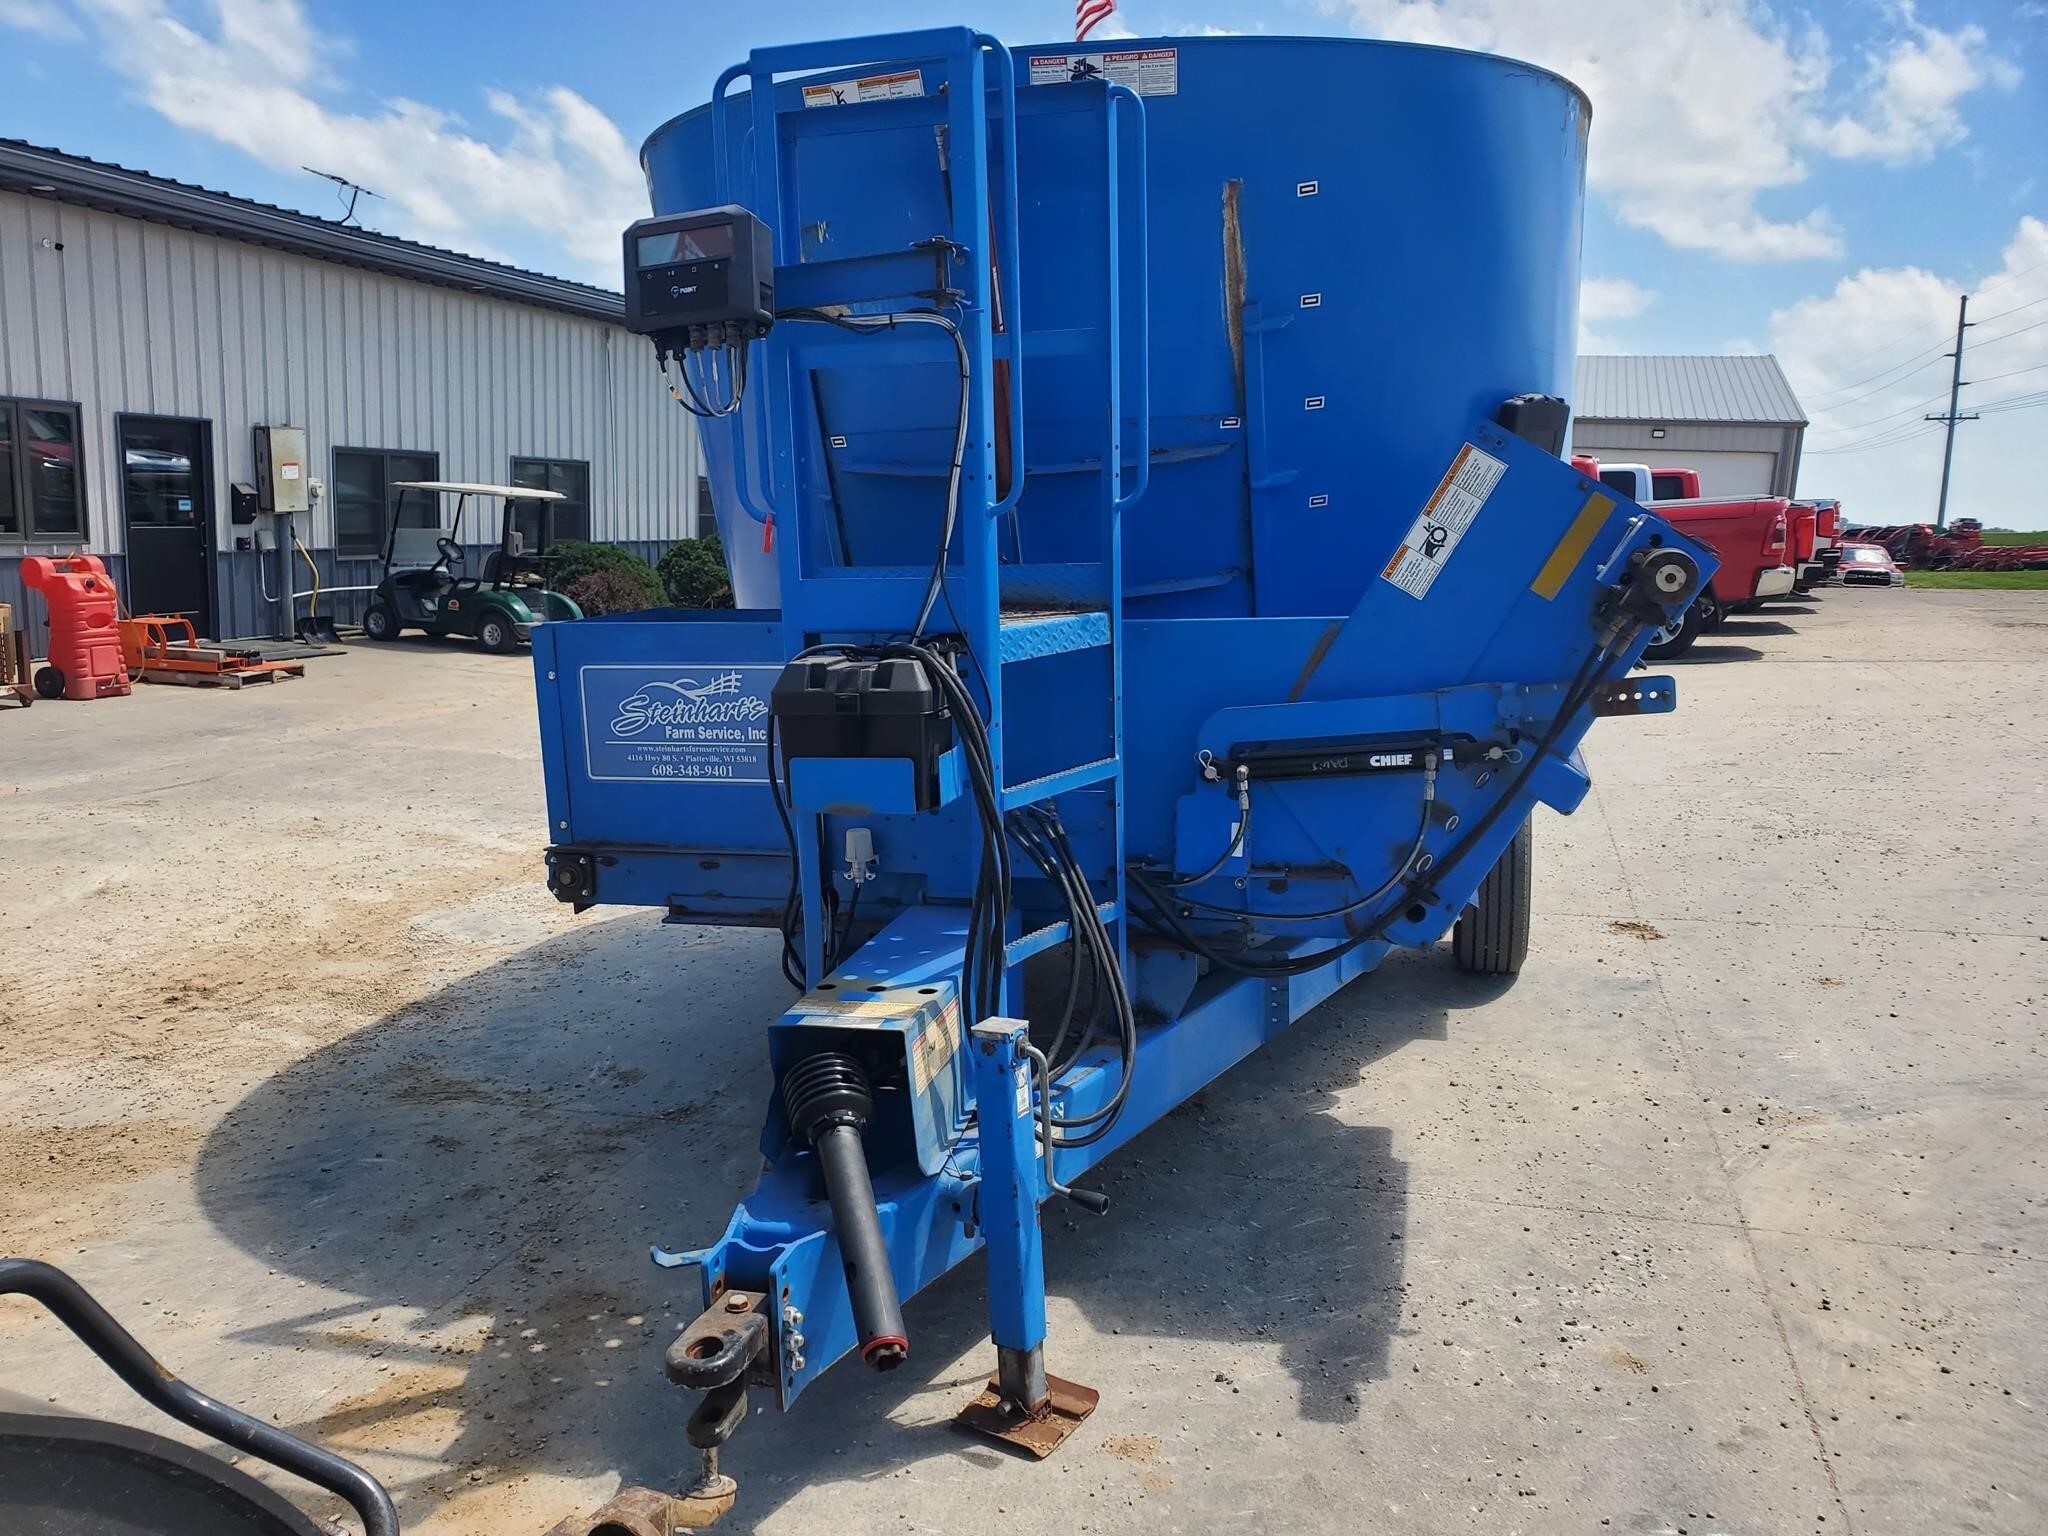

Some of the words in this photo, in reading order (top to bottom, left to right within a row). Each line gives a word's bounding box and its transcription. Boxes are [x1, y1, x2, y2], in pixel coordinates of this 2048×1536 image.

[1148, 51, 1174, 59] DANGER
[611, 695, 768, 736] Steinhart's
[665, 726, 695, 739] Farm
[698, 726, 745, 742] Service,
[645, 754, 660, 763] Hwy
[672, 754, 679, 762] S.
[685, 755, 722, 763] Platteville,
[736, 755, 757, 763] 53818
[1369, 754, 1413, 767] CHIEF
[651, 764, 733, 777] 608-348-9401
